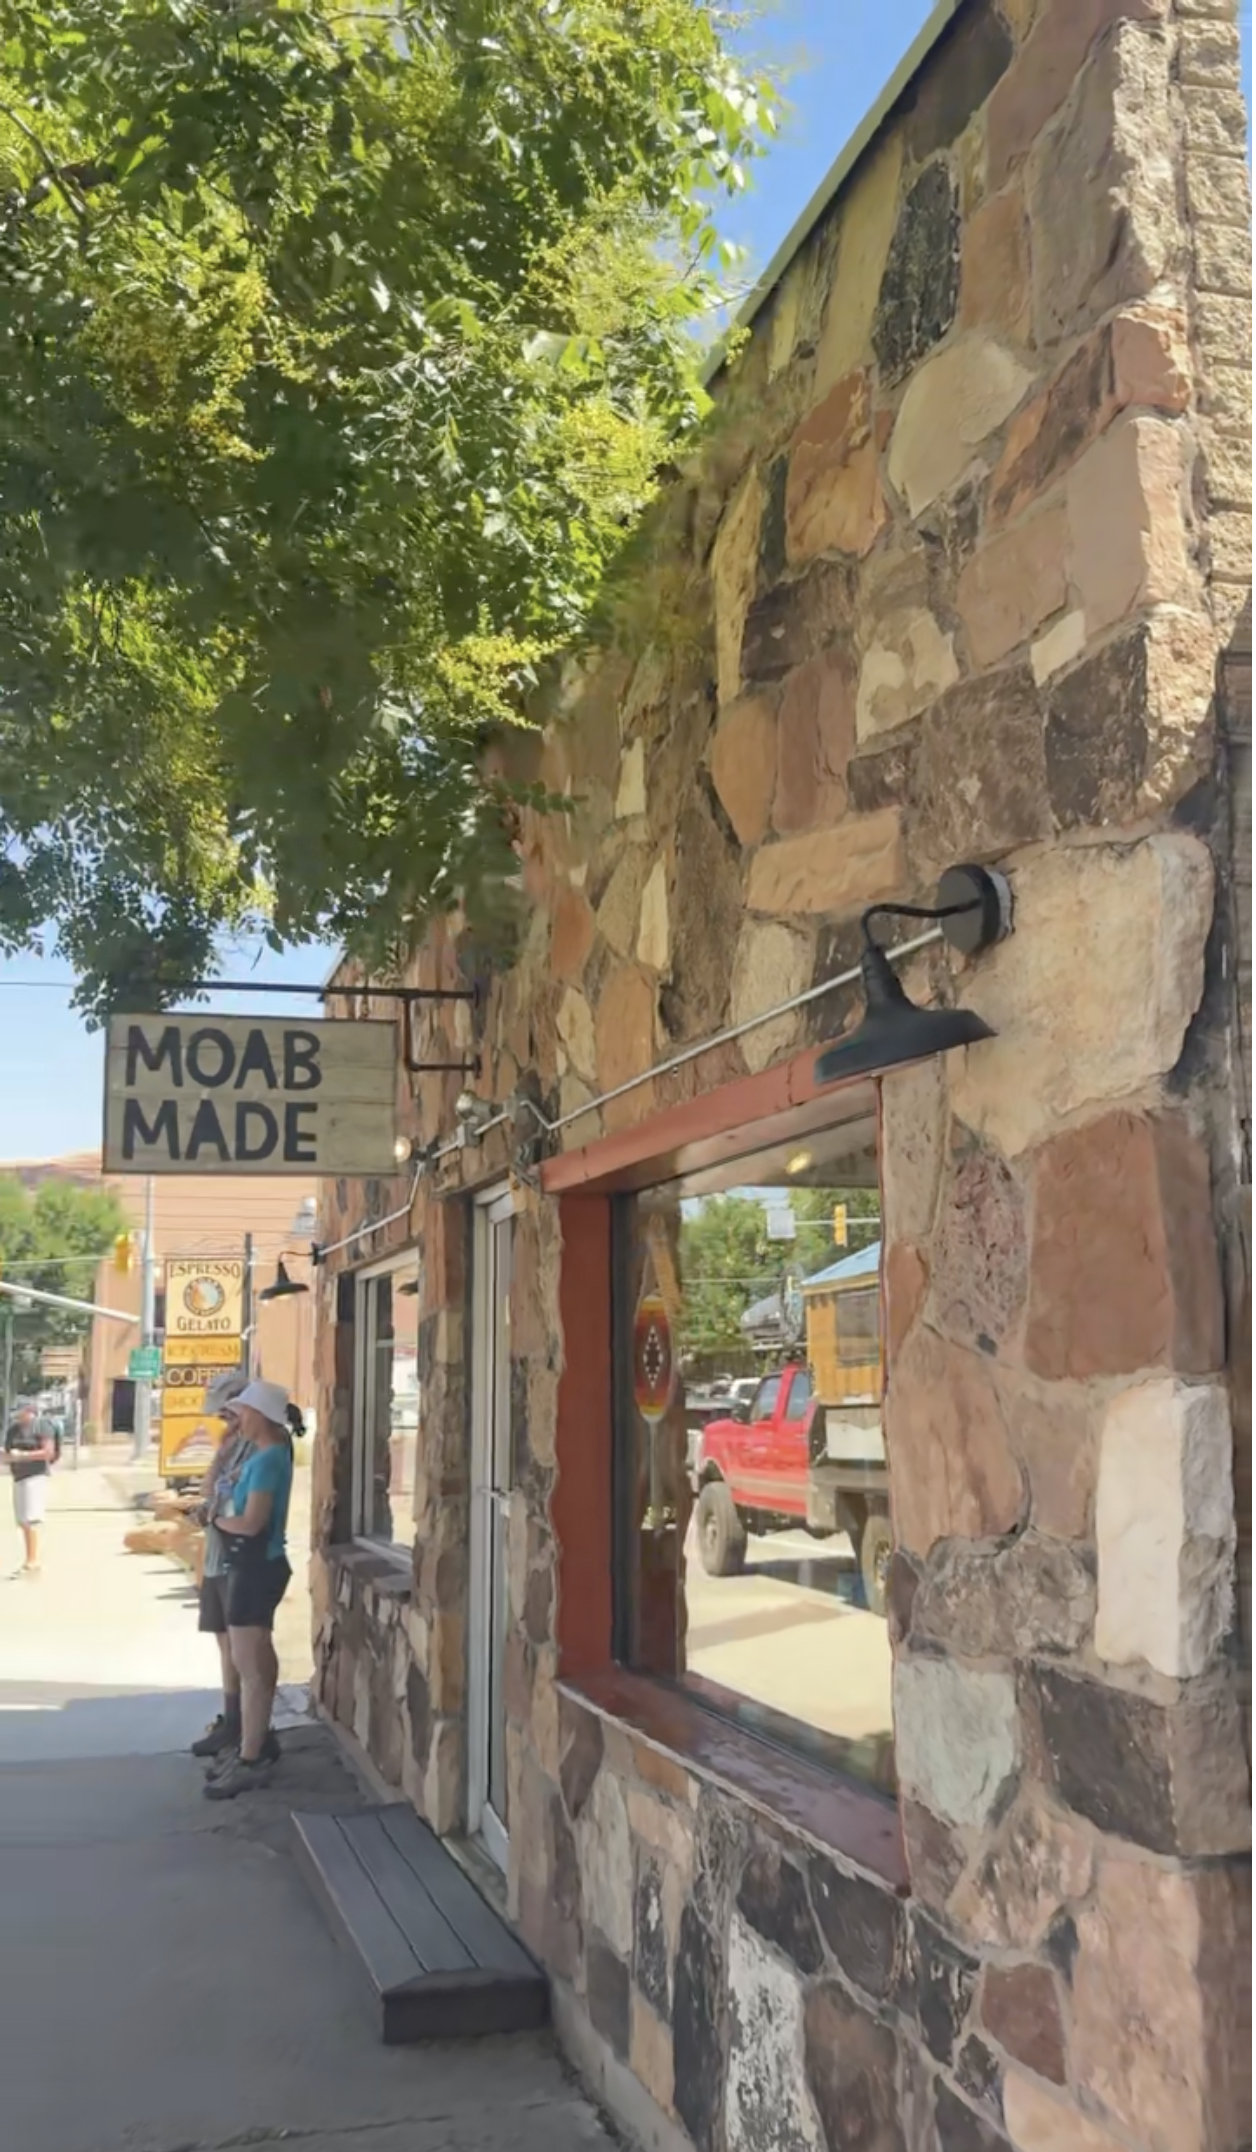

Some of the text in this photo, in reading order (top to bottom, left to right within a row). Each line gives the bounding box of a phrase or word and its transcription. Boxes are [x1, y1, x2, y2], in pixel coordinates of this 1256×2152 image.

[126, 1025, 322, 1090] MOAB
[122, 1098, 318, 1162] MADE
[170, 1262, 240, 1279] ESPRESSO
[177, 1316, 231, 1331] GELATO
